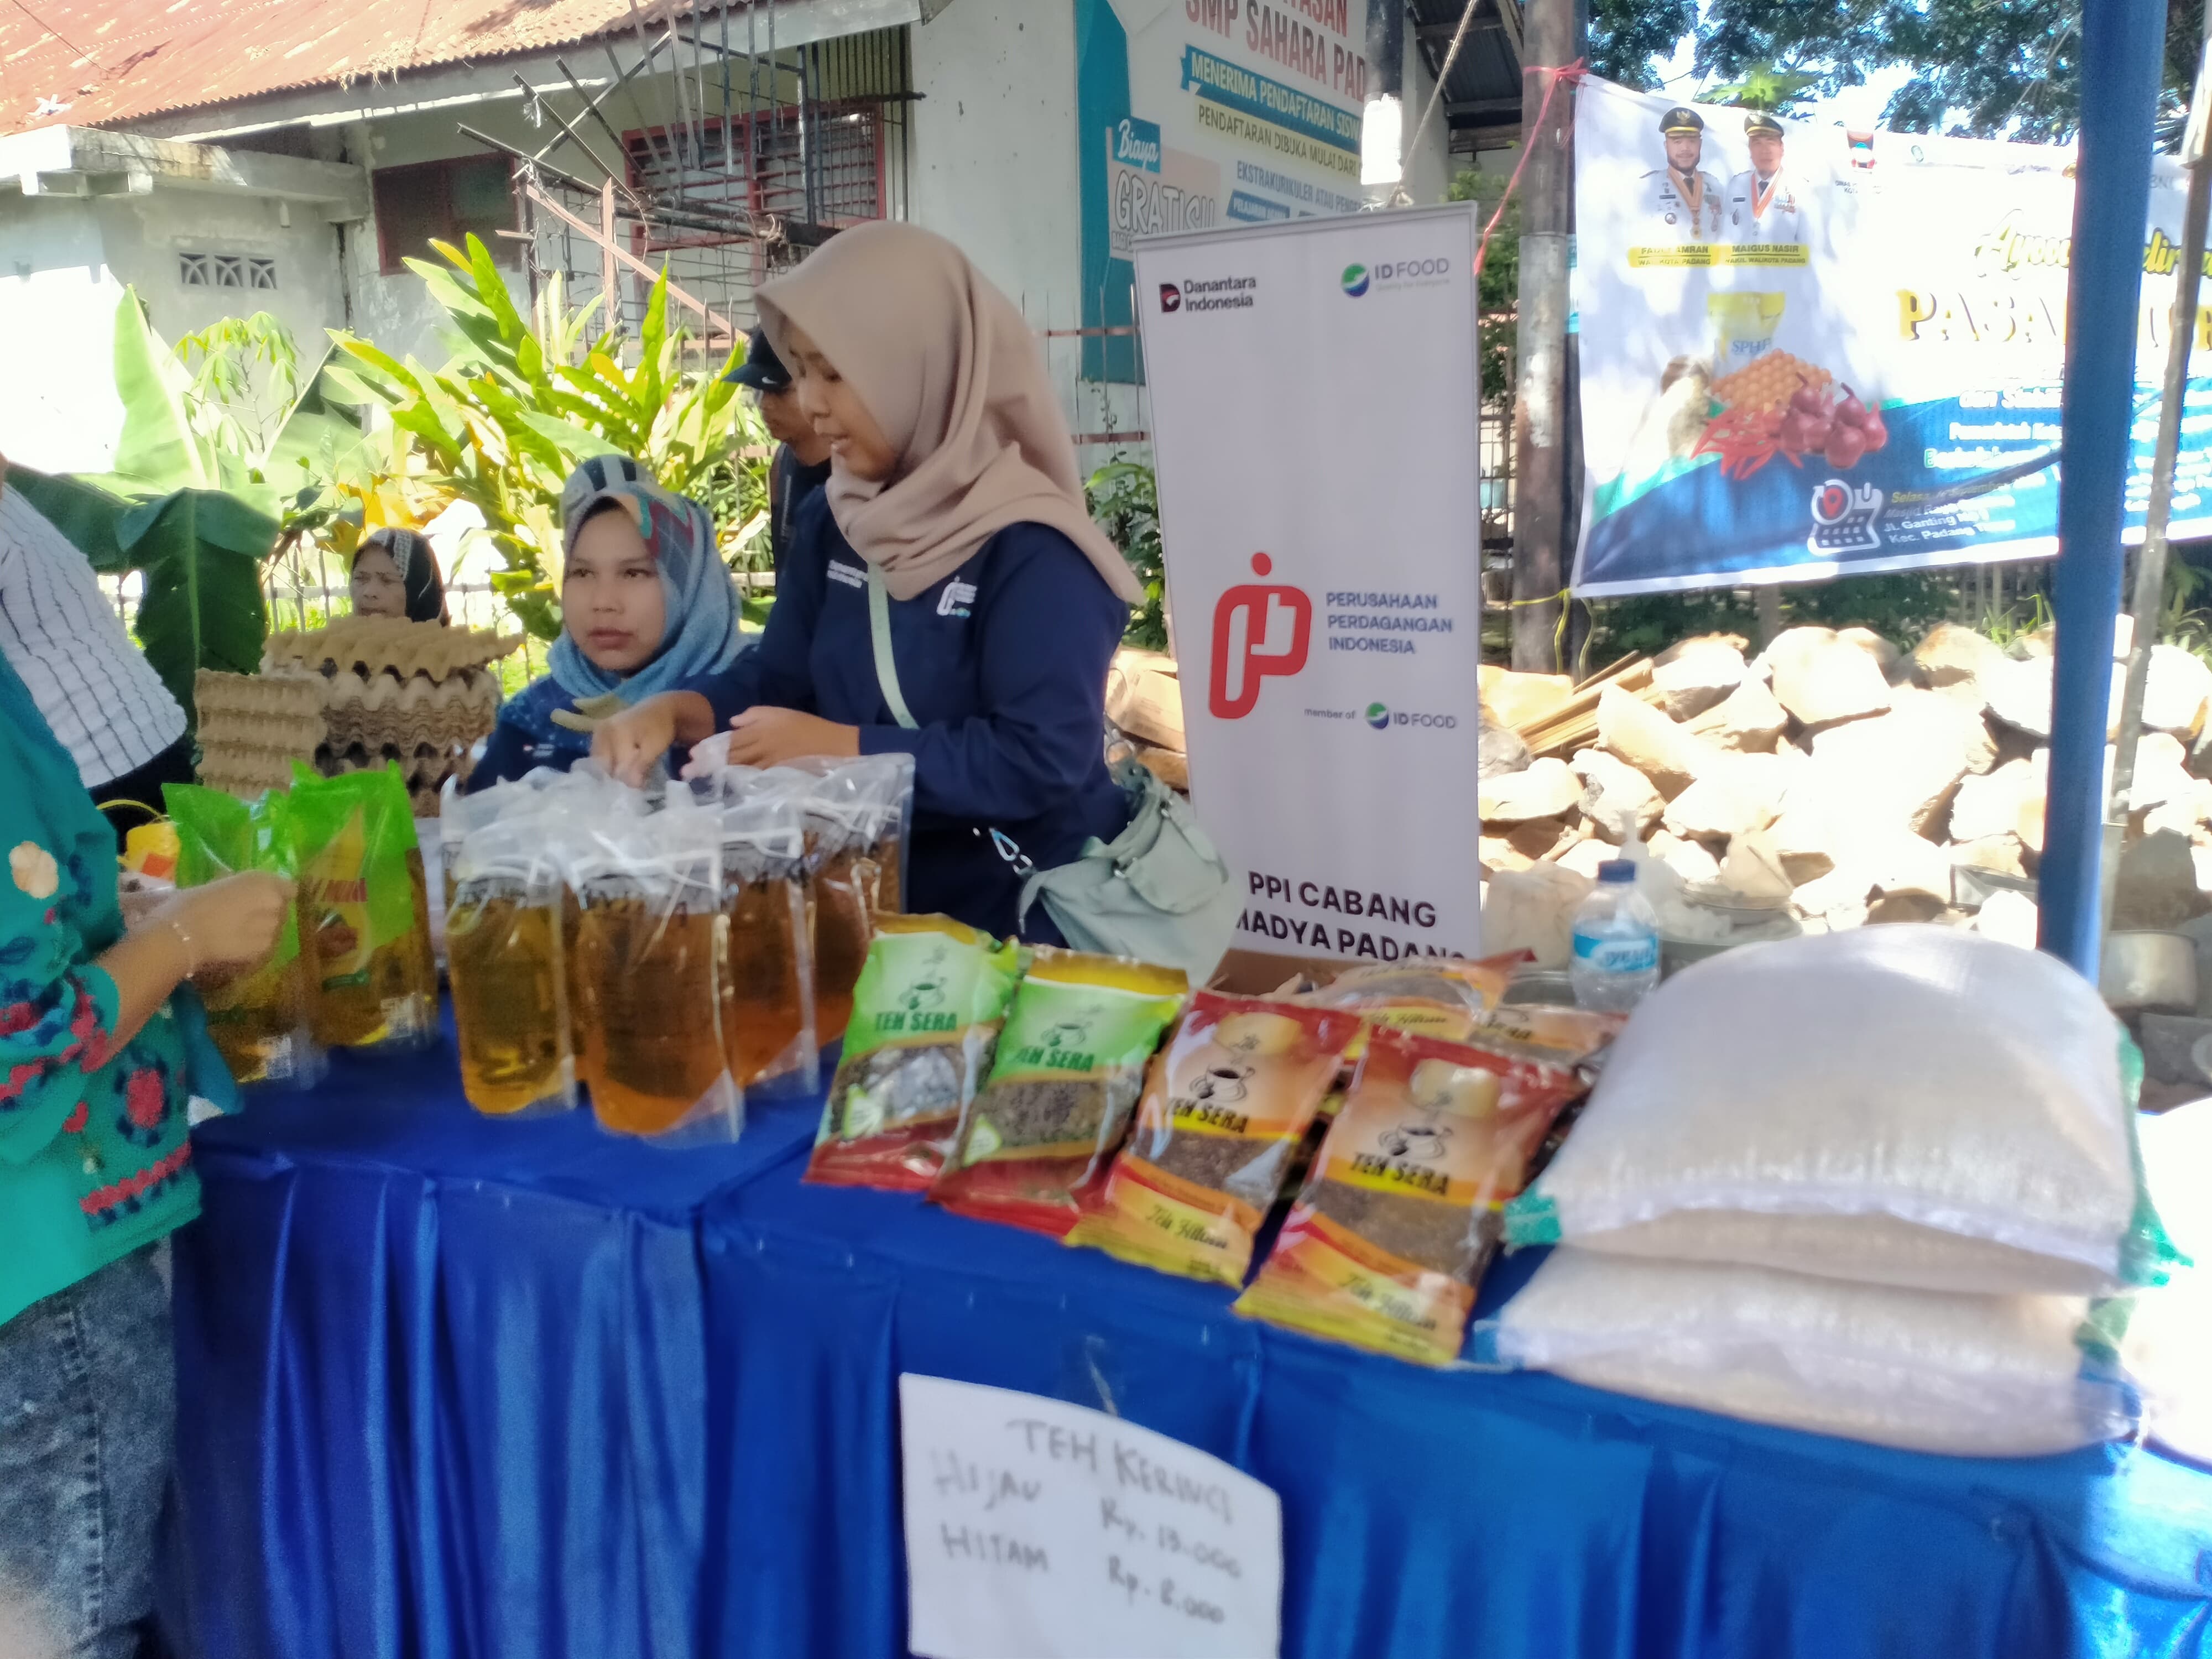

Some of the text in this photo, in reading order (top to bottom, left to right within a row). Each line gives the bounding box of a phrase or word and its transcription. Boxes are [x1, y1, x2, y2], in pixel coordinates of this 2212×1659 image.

[1246, 0, 1327, 85] SAHARA
[1191, 51, 1257, 102] MENERIMA
[1260, 80, 1334, 132] PENDAFTARAN
[1118, 118, 1159, 169] Biaya
[1198, 104, 1271, 147] PENDAFTARAN
[1274, 133, 1307, 159] DIBUKA
[1309, 145, 1337, 169] MULAI
[1338, 155, 1357, 177] DARI
[1237, 160, 1313, 202] EKSTRAKURIKULER
[1316, 191, 1334, 211] ATAU
[1676, 245, 1709, 254] AMRAN
[1731, 244, 1770, 253] MAIGUS
[1375, 258, 1449, 280] ID FOOD
[1183, 276, 1257, 294] Danantara
[1185, 295, 1254, 313] Indonesia
[1895, 289, 2069, 345] PASA
[1884, 505, 1921, 519] Masjid
[1901, 515, 1957, 529] Ganting
[1888, 534, 1920, 544] Kec.
[1921, 526, 1975, 540] Padang
[1326, 592, 1438, 609] PERUSAHAAN
[1327, 614, 1453, 633] PERDAGANGAN
[1328, 637, 1416, 655] INDONESIA
[1304, 707, 1357, 720] member of
[1393, 712, 1458, 729] ID FOOD
[1248, 870, 1437, 928] PPI CABANG
[875, 1011, 958, 1032] TEH SERA
[1011, 1045, 1095, 1073] EH SERA
[1196, 1102, 1250, 1134] SERA
[1349, 1151, 1450, 1197] TEH SERA
[1005, 1417, 1098, 1472] TEH
[931, 1447, 1042, 1511] HIJAU
[940, 1522, 1048, 1572] HITAM
